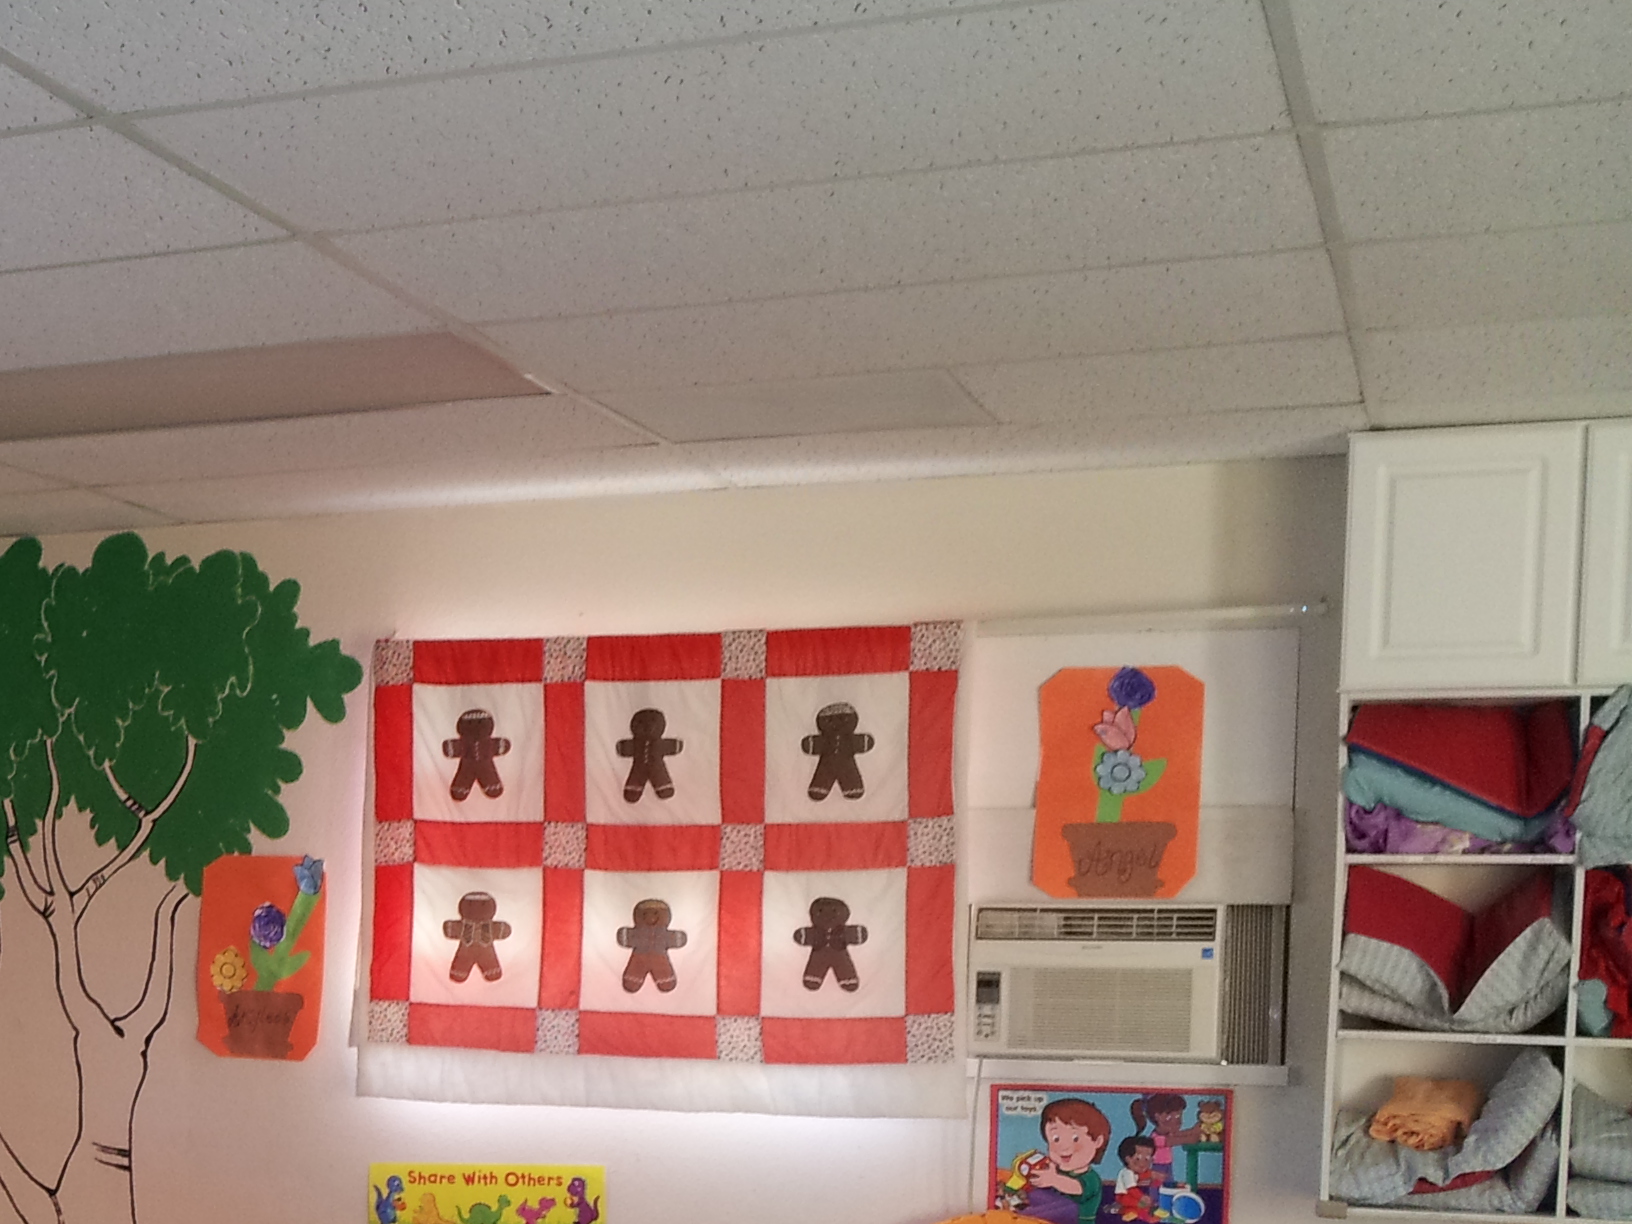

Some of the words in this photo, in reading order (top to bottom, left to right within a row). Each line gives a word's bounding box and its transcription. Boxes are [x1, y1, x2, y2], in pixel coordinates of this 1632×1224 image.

[407, 1170, 456, 1186] Share
[462, 1170, 499, 1187] With
[504, 1171, 564, 1188] Others
